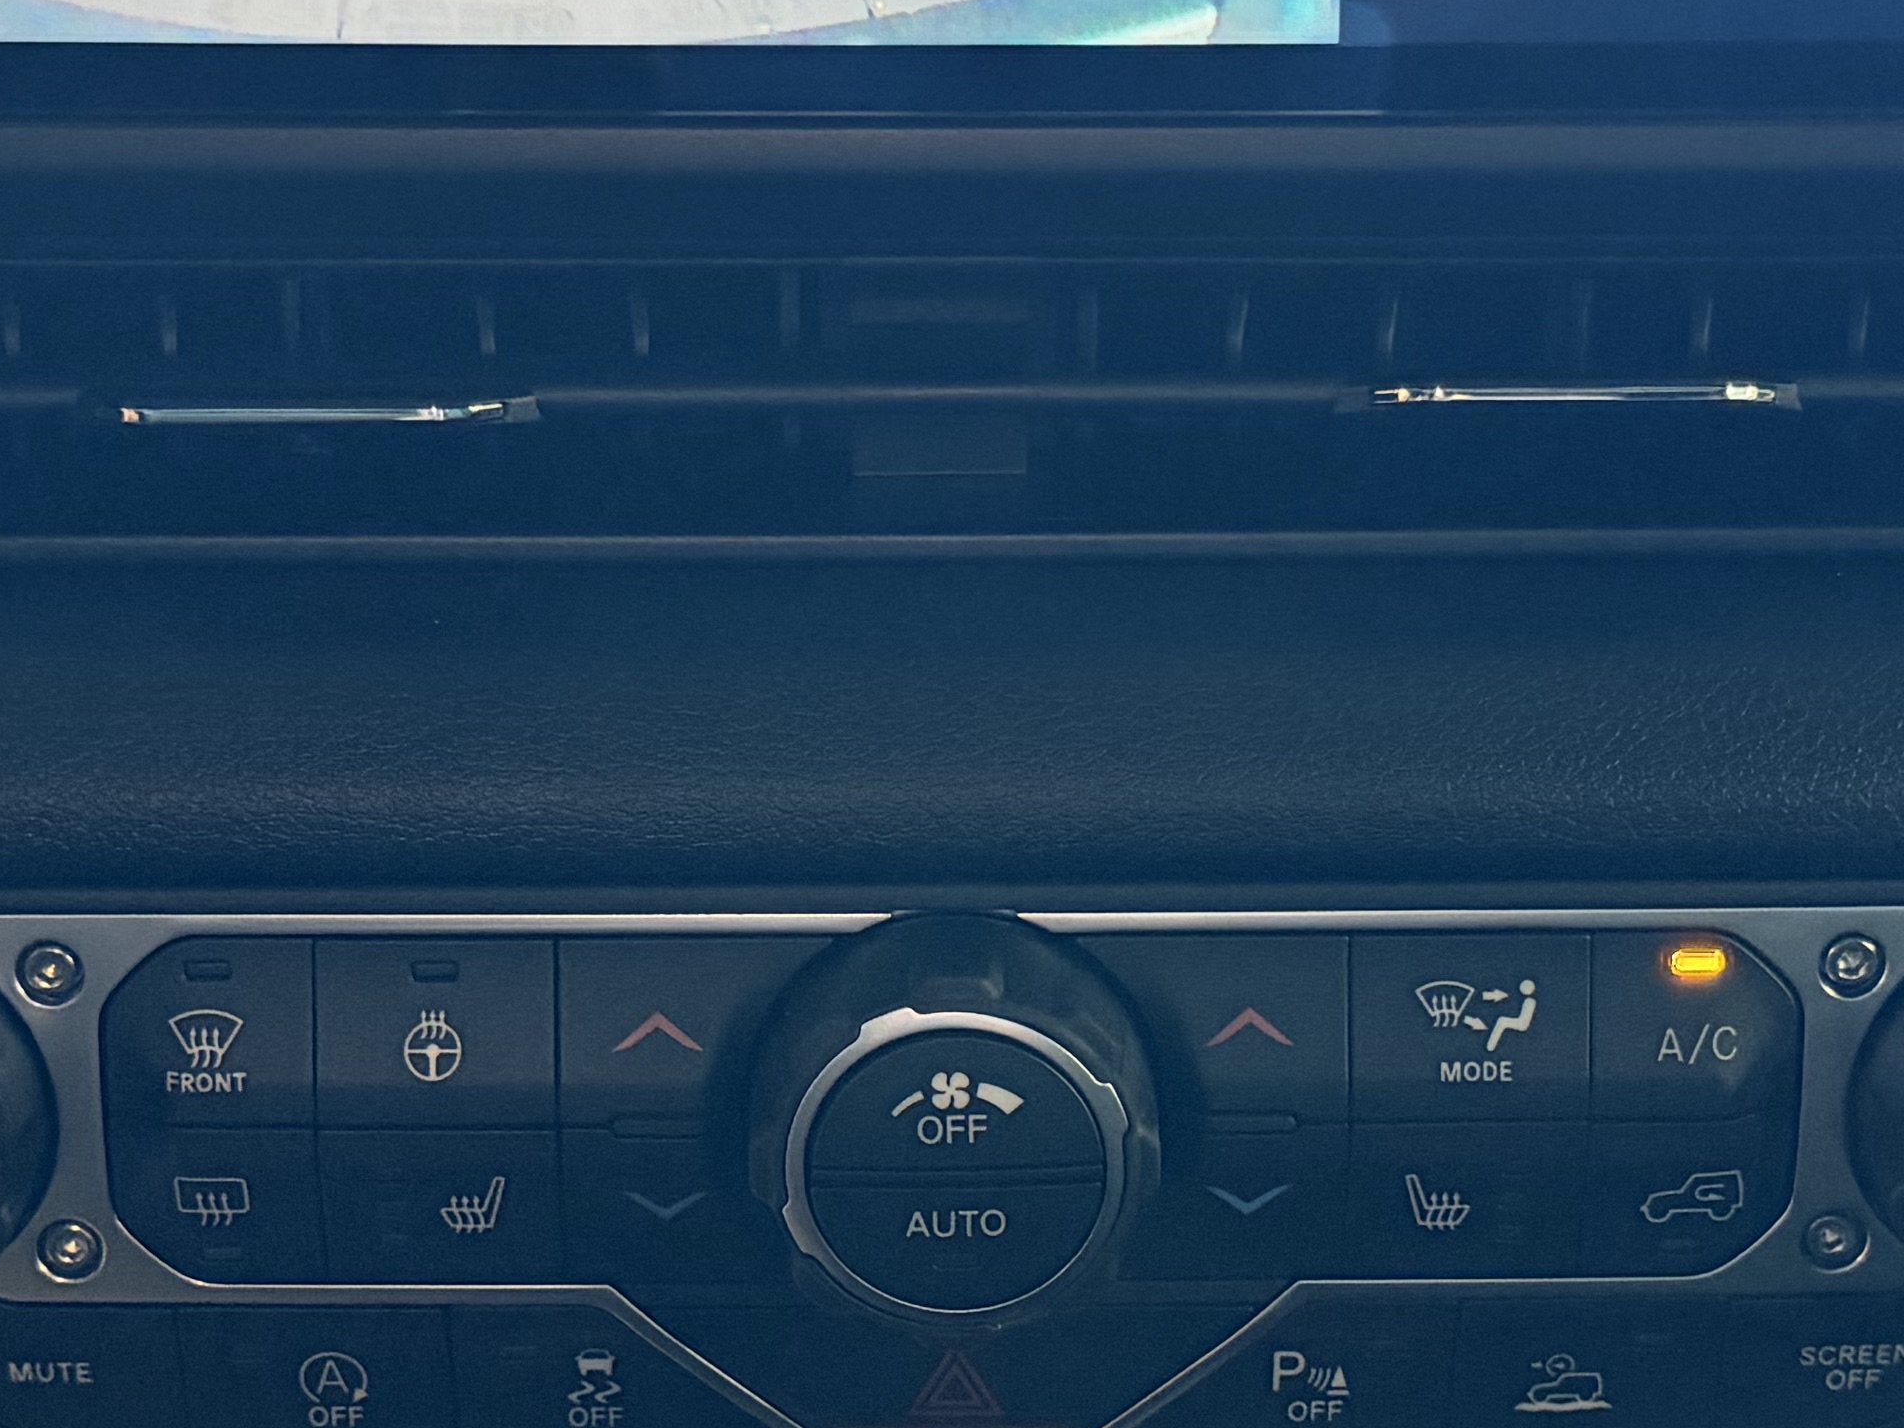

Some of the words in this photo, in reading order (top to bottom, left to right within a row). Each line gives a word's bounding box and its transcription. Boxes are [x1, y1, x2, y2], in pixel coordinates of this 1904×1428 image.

[1656, 1025, 1740, 1064] A/C
[165, 1071, 248, 1094] FRONT
[1439, 1061, 1514, 1082] MODE
[915, 1115, 988, 1145] OFF
[905, 1208, 1006, 1238] AUTO
[7, 1361, 94, 1384] MUTE
[1825, 1368, 1882, 1391] OFF
[308, 1406, 364, 1428] OFF
[567, 1406, 624, 1428] OFF
[1287, 1400, 1343, 1422] OFF
